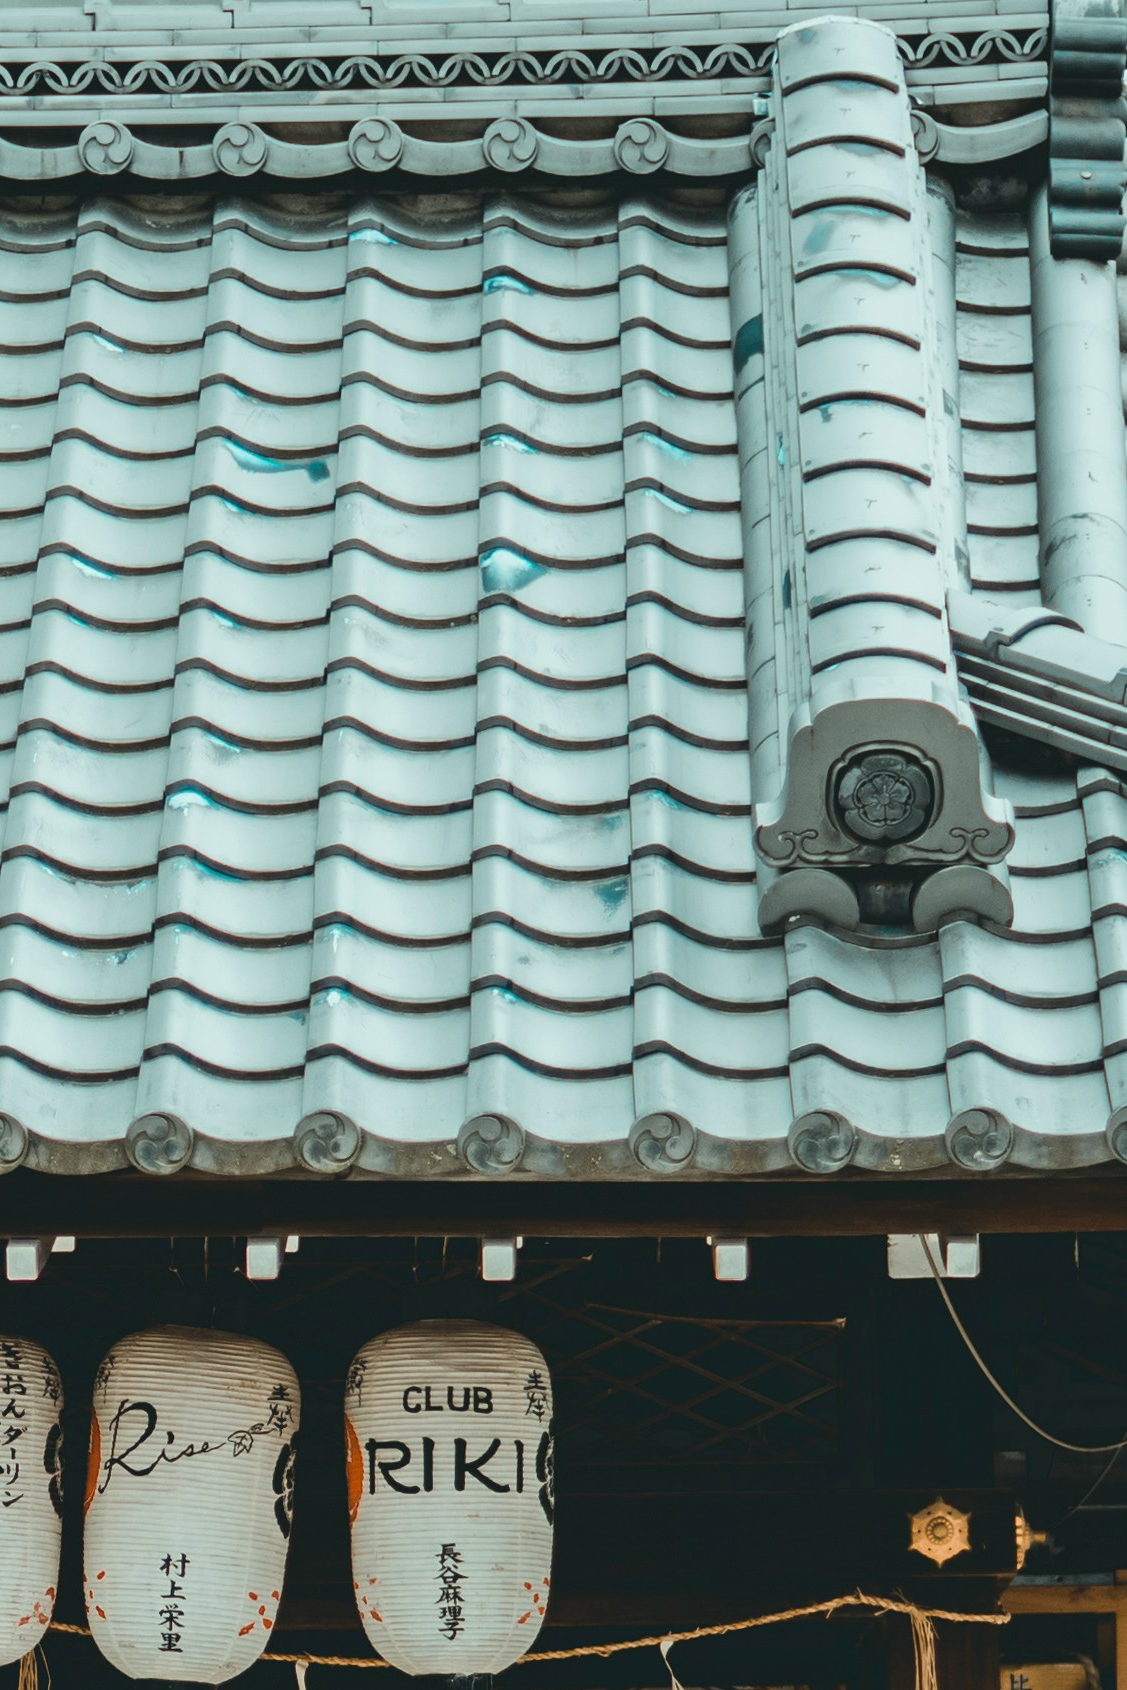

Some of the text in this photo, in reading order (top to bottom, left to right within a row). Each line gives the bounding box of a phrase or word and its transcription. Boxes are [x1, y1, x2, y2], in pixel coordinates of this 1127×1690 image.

[1, 1343, 28, 1507] ぎおんダーリン
[99, 1399, 226, 1494] Rise
[402, 1386, 494, 1414] CLUB
[365, 1437, 524, 1494] RIKI
[158, 1553, 190, 1654] 村上栄里
[435, 1544, 469, 1641] 長谷麻理子
